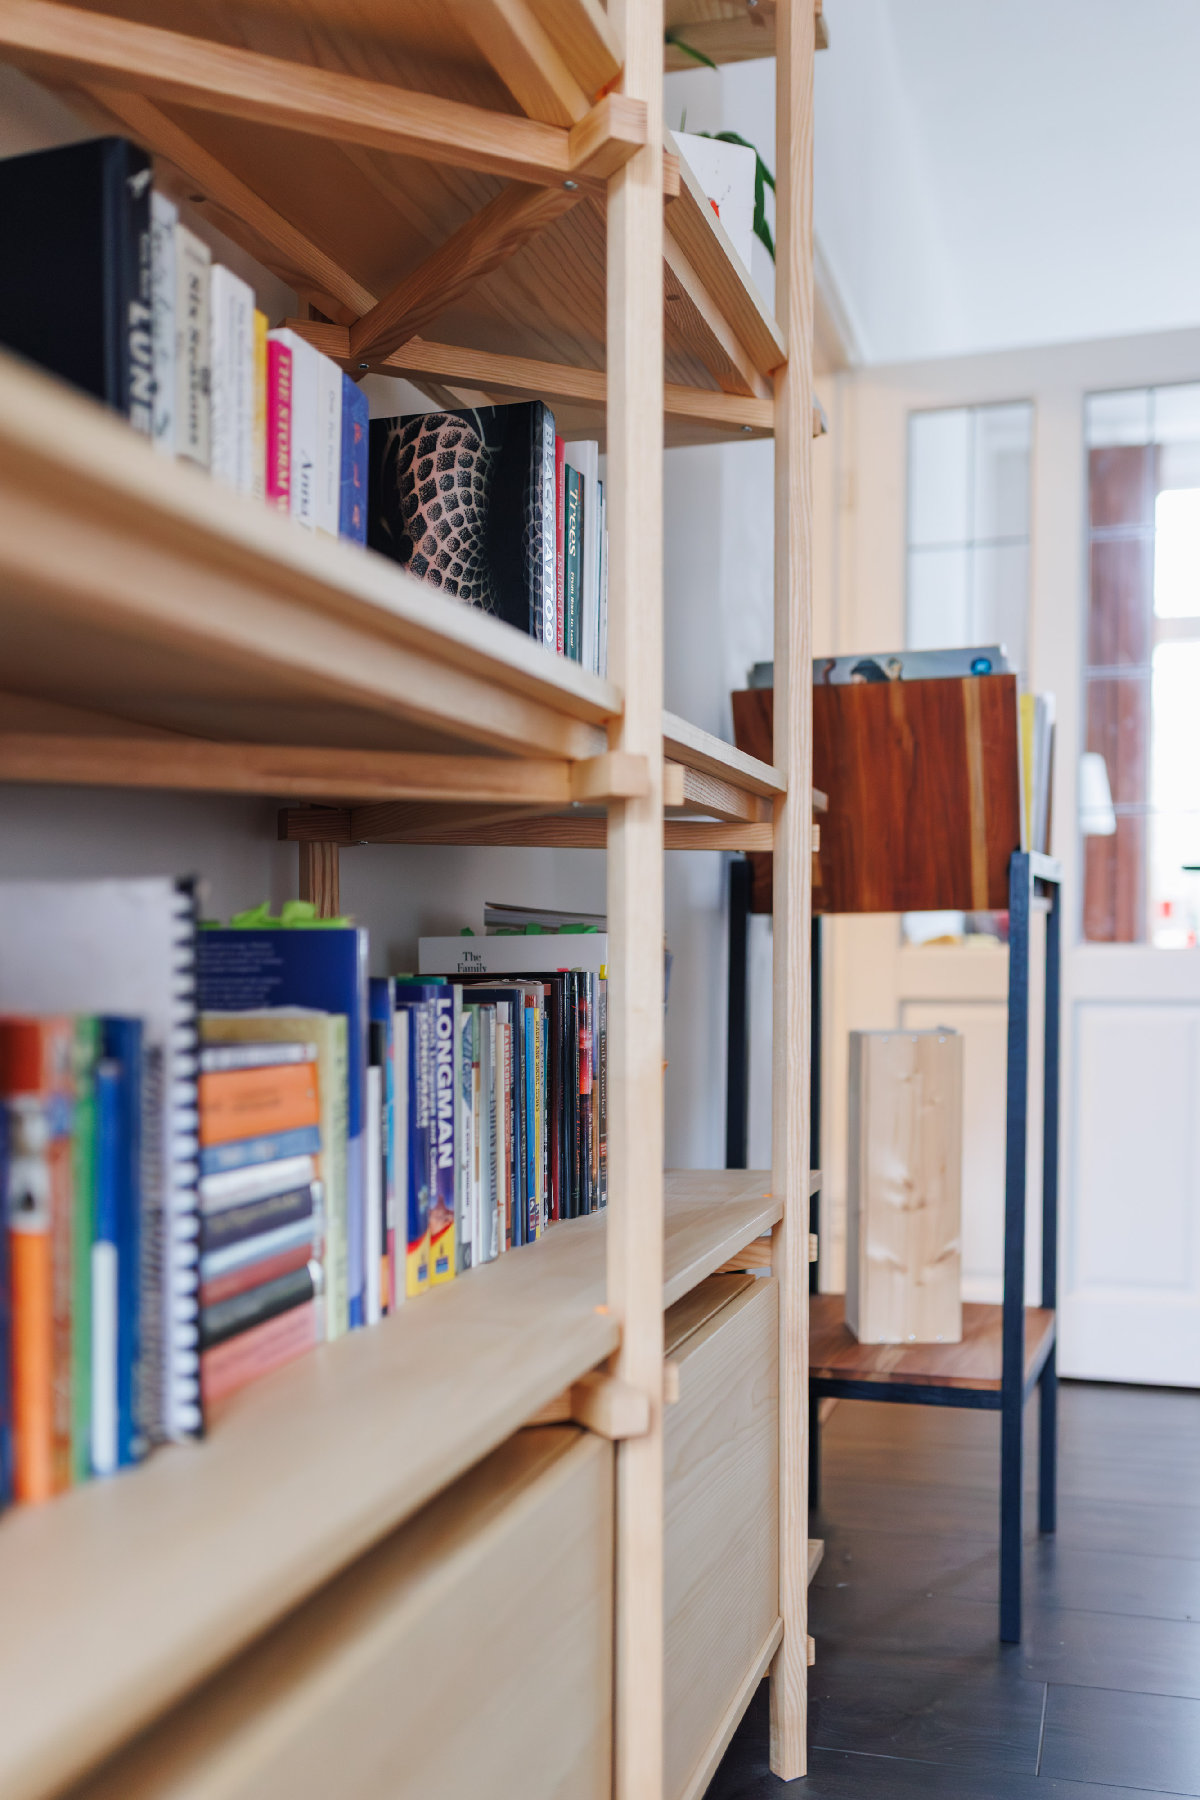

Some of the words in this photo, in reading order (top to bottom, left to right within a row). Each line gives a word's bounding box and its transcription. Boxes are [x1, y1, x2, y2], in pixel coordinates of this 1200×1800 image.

[278, 353, 290, 403] THE
[278, 404, 290, 488] STORM
[543, 422, 553, 521] BLACK
[568, 488, 579, 557] Trees
[544, 528, 554, 643] TATTOO
[457, 962, 487, 973] Family
[462, 951, 482, 961] The
[436, 998, 453, 1169] LONGMAN
